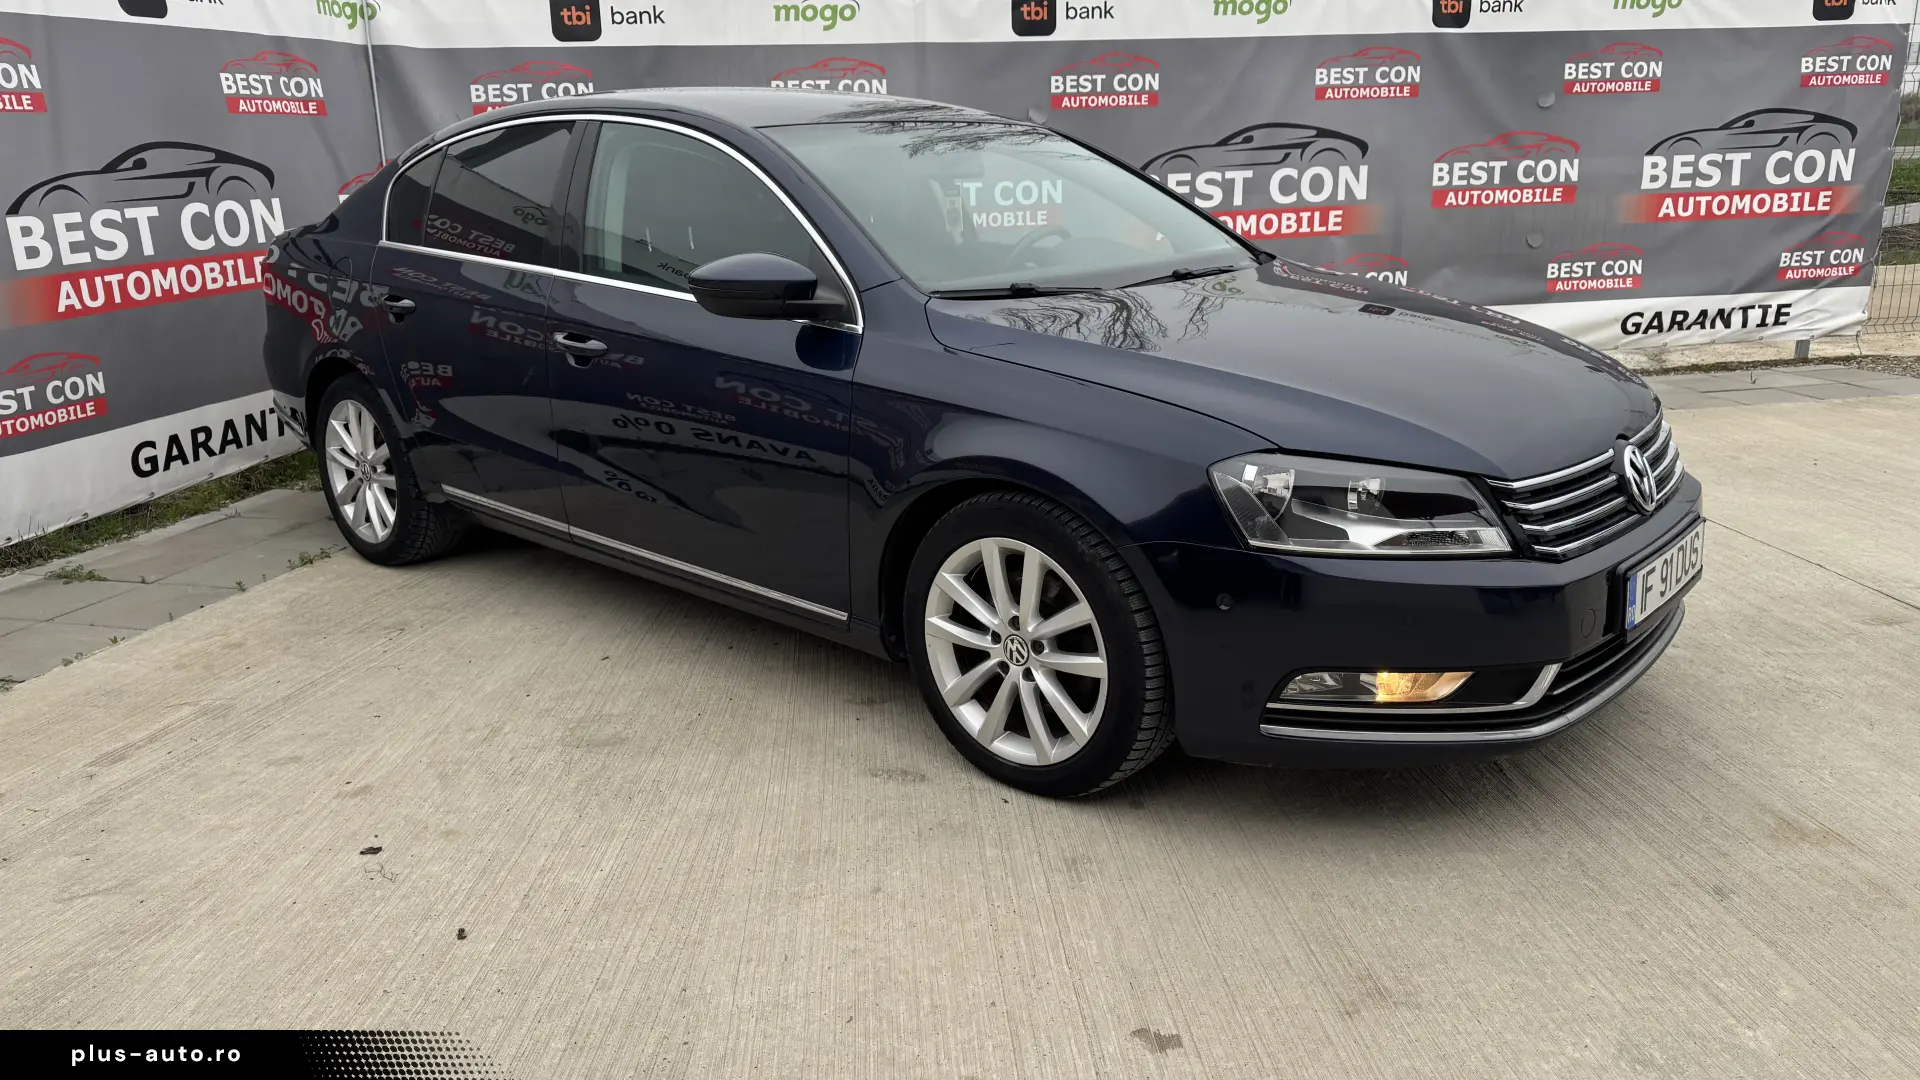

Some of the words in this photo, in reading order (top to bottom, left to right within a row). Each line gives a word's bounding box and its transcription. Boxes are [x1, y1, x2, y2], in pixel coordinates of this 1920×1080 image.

[561, 5, 592, 25] tbi
[610, 5, 665, 25] bank
[1021, 1, 1048, 20] tbi
[1066, 1, 1114, 20] bank
[1213, 0, 1288, 24] mogo
[1479, 0, 1524, 13] bank
[773, 3, 857, 31] mogo
[1564, 62, 1615, 79] BEST
[1621, 61, 1662, 78] CON
[1801, 55, 1852, 73] BEST
[1856, 54, 1892, 71] CON
[0, 63, 42, 89] ON
[219, 72, 273, 95] BEST
[279, 76, 324, 98] CON
[1050, 74, 1106, 93] BEST
[1113, 73, 1159, 91] CON
[1315, 67, 1368, 85] BEST
[1375, 65, 1420, 83] CON
[1808, 74, 1882, 86] AUTOMOBILE
[470, 83, 532, 102] BEST
[541, 82, 594, 100] CON
[1325, 86, 1411, 99] AUTOMOBILE
[1572, 81, 1652, 93] AUTOMOBILE
[238, 98, 318, 114] AUTOMOBILE
[1061, 94, 1149, 108] AUTOMOBILE
[1432, 160, 1508, 186] BEST
[1516, 158, 1579, 184] CON
[1641, 152, 1751, 189] BEST
[1765, 148, 1856, 184] CON
[994, 180, 1063, 206] CON
[1151, 169, 1253, 208] EST
[1269, 165, 1369, 204] CON
[1445, 187, 1563, 206] AUTOMOBILE
[1657, 190, 1832, 218] AUTOMOBILE
[973, 210, 1048, 228] MOBILE
[1218, 209, 1343, 236] MOBILE
[5, 206, 160, 271] BEST
[180, 197, 285, 251] CON
[1779, 250, 1825, 268] BEST
[1830, 247, 1865, 264] CON
[1547, 261, 1596, 278] BEST
[1601, 259, 1642, 276] CON
[1785, 266, 1855, 280] AUTOMOBILE
[1555, 278, 1633, 291] AUTOMOBILE
[1620, 303, 1793, 336] GARANTIE
[0, 385, 36, 415] ST
[46, 371, 106, 404] CON
[0, 401, 96, 435] TOMOBILE
[131, 407, 285, 478] GARANT
[1640, 565, 1656, 615] IF
[1659, 552, 1674, 598] 91
[1675, 530, 1700, 587] DUS
